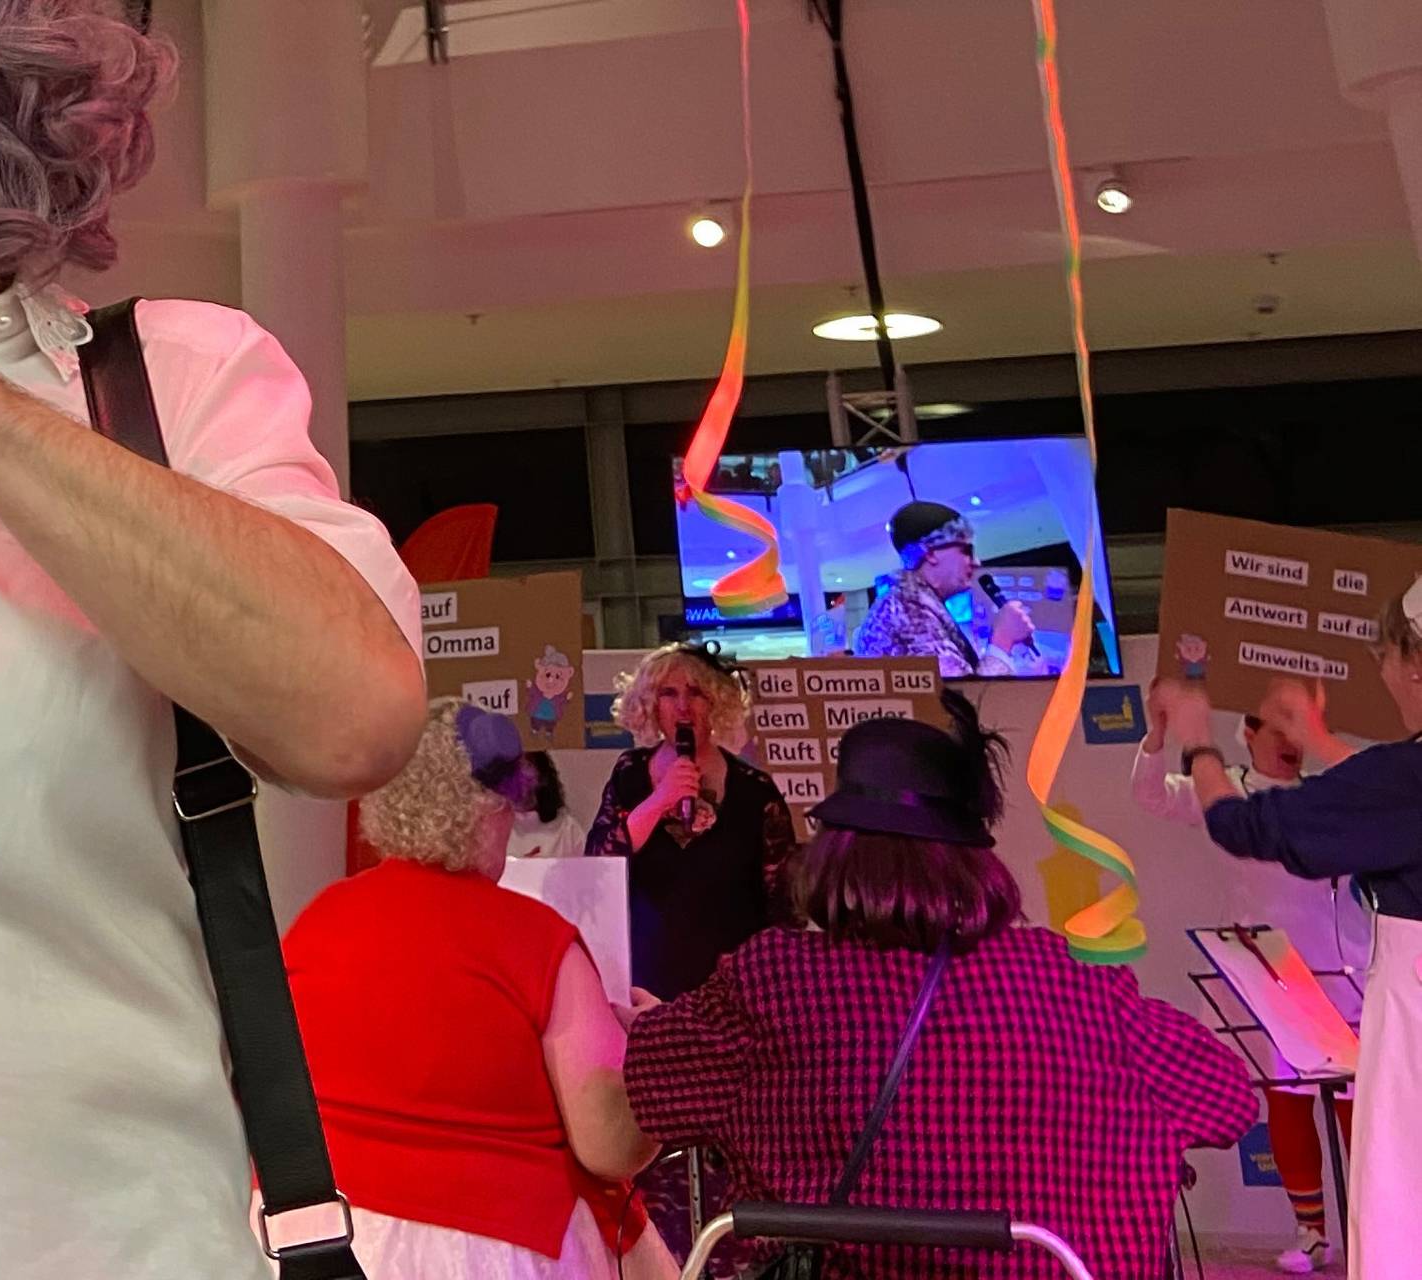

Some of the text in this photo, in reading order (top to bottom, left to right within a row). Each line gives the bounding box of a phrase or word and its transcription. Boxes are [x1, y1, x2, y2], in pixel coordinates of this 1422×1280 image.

[1231, 554, 1364, 590] Wir sind die
[1229, 600, 1303, 625] Antwort
[1322, 618, 1352, 633] auf
[427, 635, 495, 654] Omma
[760, 674, 932, 693] die Omma aus
[757, 709, 805, 728] dem
[768, 743, 815, 761] Ruft
